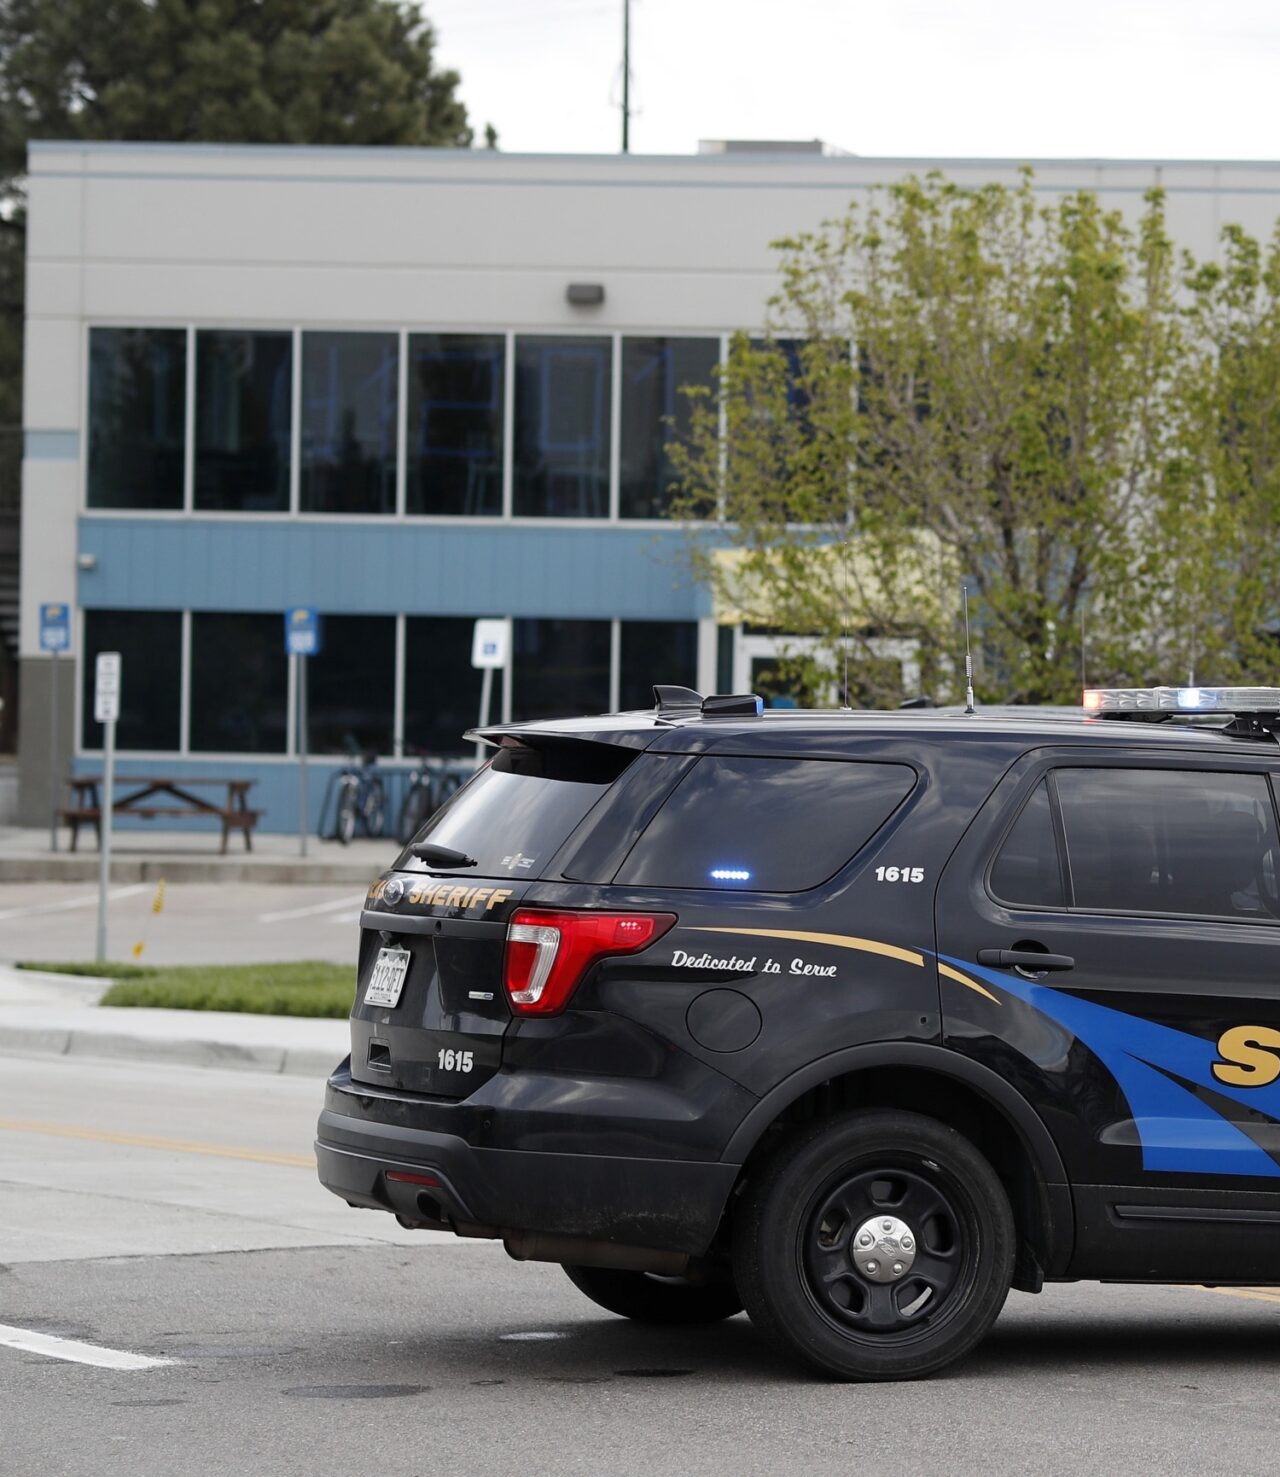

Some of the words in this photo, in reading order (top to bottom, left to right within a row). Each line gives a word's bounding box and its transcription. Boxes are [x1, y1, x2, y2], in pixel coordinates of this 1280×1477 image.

[875, 866, 925, 883] 1615
[409, 882, 513, 910] SHERIFF
[670, 950, 757, 972] Dedicated
[761, 958, 781, 974] to
[788, 957, 837, 977] Serve
[438, 1048, 474, 1074] 1615
